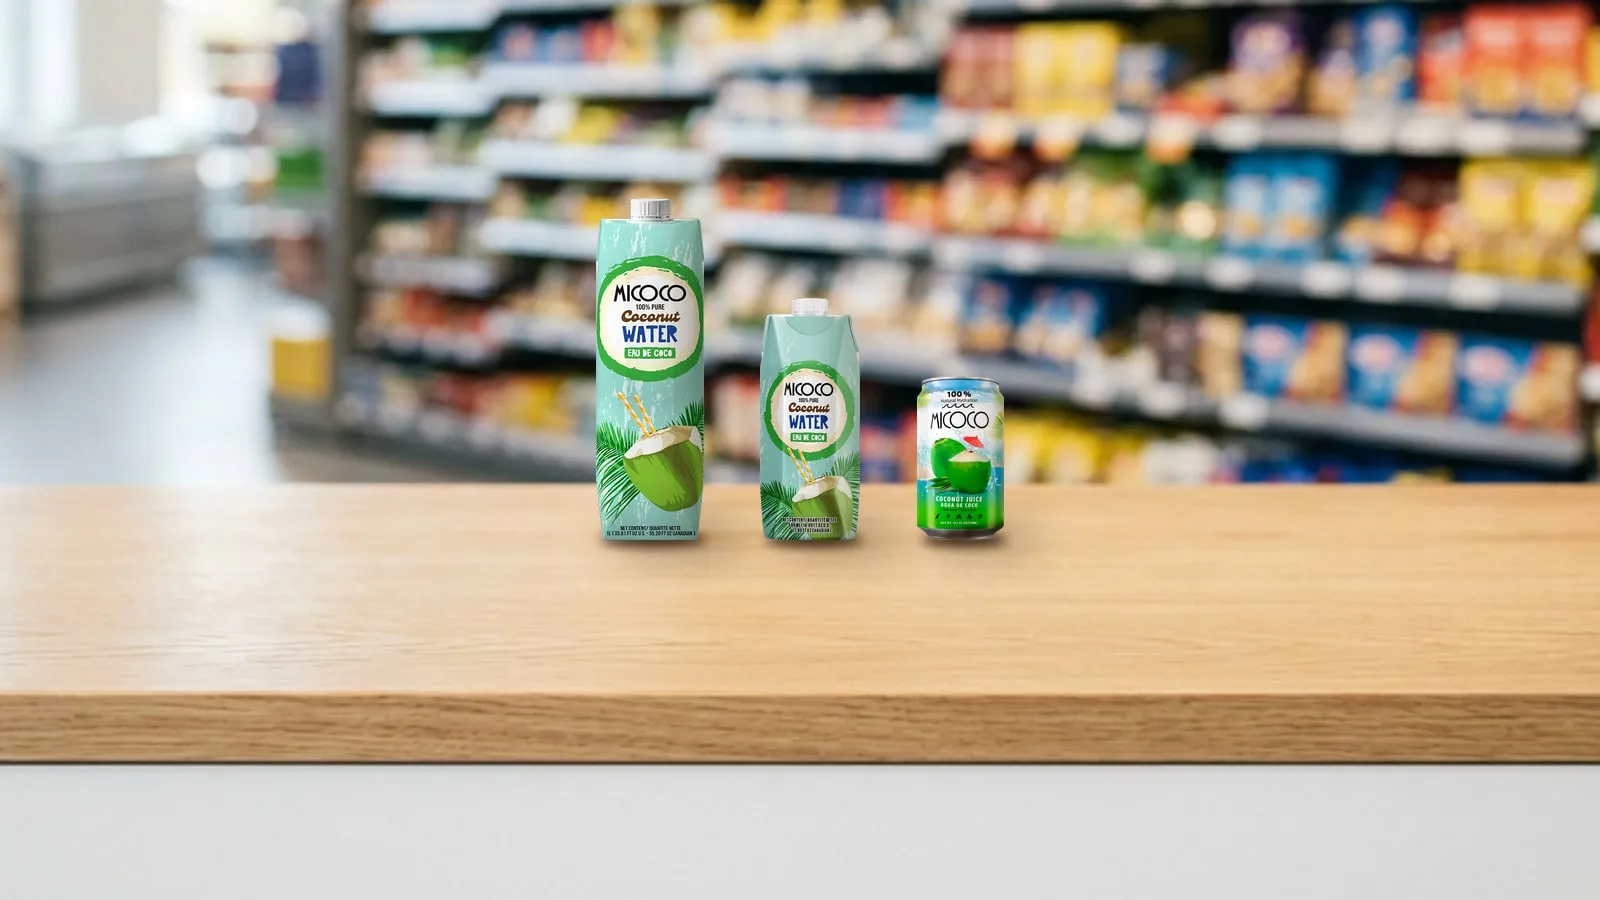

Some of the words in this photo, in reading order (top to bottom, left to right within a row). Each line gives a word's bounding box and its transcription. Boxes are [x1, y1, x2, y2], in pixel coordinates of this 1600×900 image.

[614, 284, 686, 302] MICOCO
[621, 310, 680, 322] Coconut
[622, 325, 677, 343] WATER
[784, 382, 834, 396] MICOCO
[788, 402, 830, 412] Coconut
[789, 415, 828, 429] WATER
[930, 411, 989, 429] MICOCO
